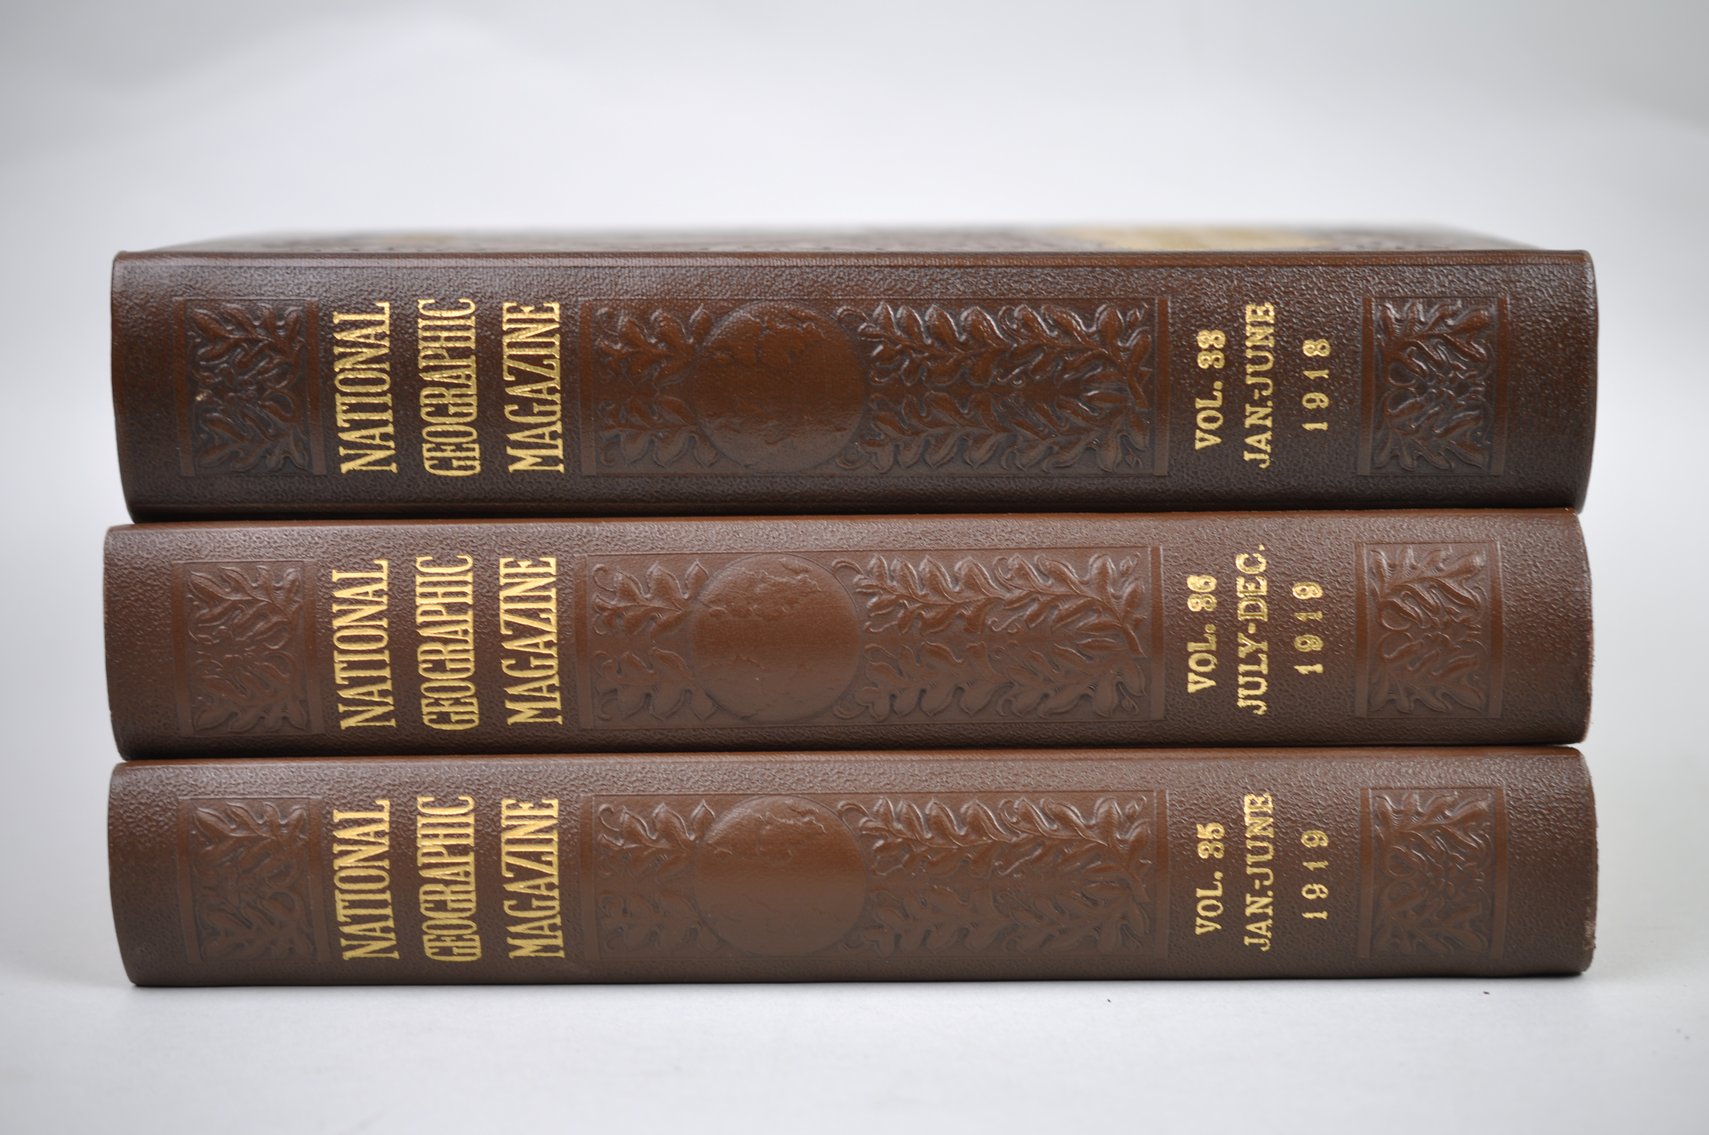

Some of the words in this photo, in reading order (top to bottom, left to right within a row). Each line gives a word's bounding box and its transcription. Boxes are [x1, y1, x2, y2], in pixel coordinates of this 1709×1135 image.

[333, 300, 397, 473] NATIONAL
[417, 298, 481, 476] GEOGRAPHIC
[502, 300, 565, 473] MAGAZINE
[1195, 381, 1225, 450] VOL.
[1243, 302, 1275, 469] JAN.-JUNE
[332, 558, 396, 730] NATIONAL
[415, 553, 480, 730] GEOGRAPHIC
[499, 556, 563, 725] MAGAZINE
[1187, 623, 1218, 693] VOL.
[1235, 544, 1269, 715] JULY-DEC.
[333, 798, 400, 961] NATIONAL
[416, 795, 482, 962] GEOGRAPHIC
[501, 798, 565, 959] MAGAZINE
[1195, 871, 1224, 934] VOL.
[1196, 822, 1225, 859] 35
[1243, 792, 1275, 952] JAN.-JUNE
